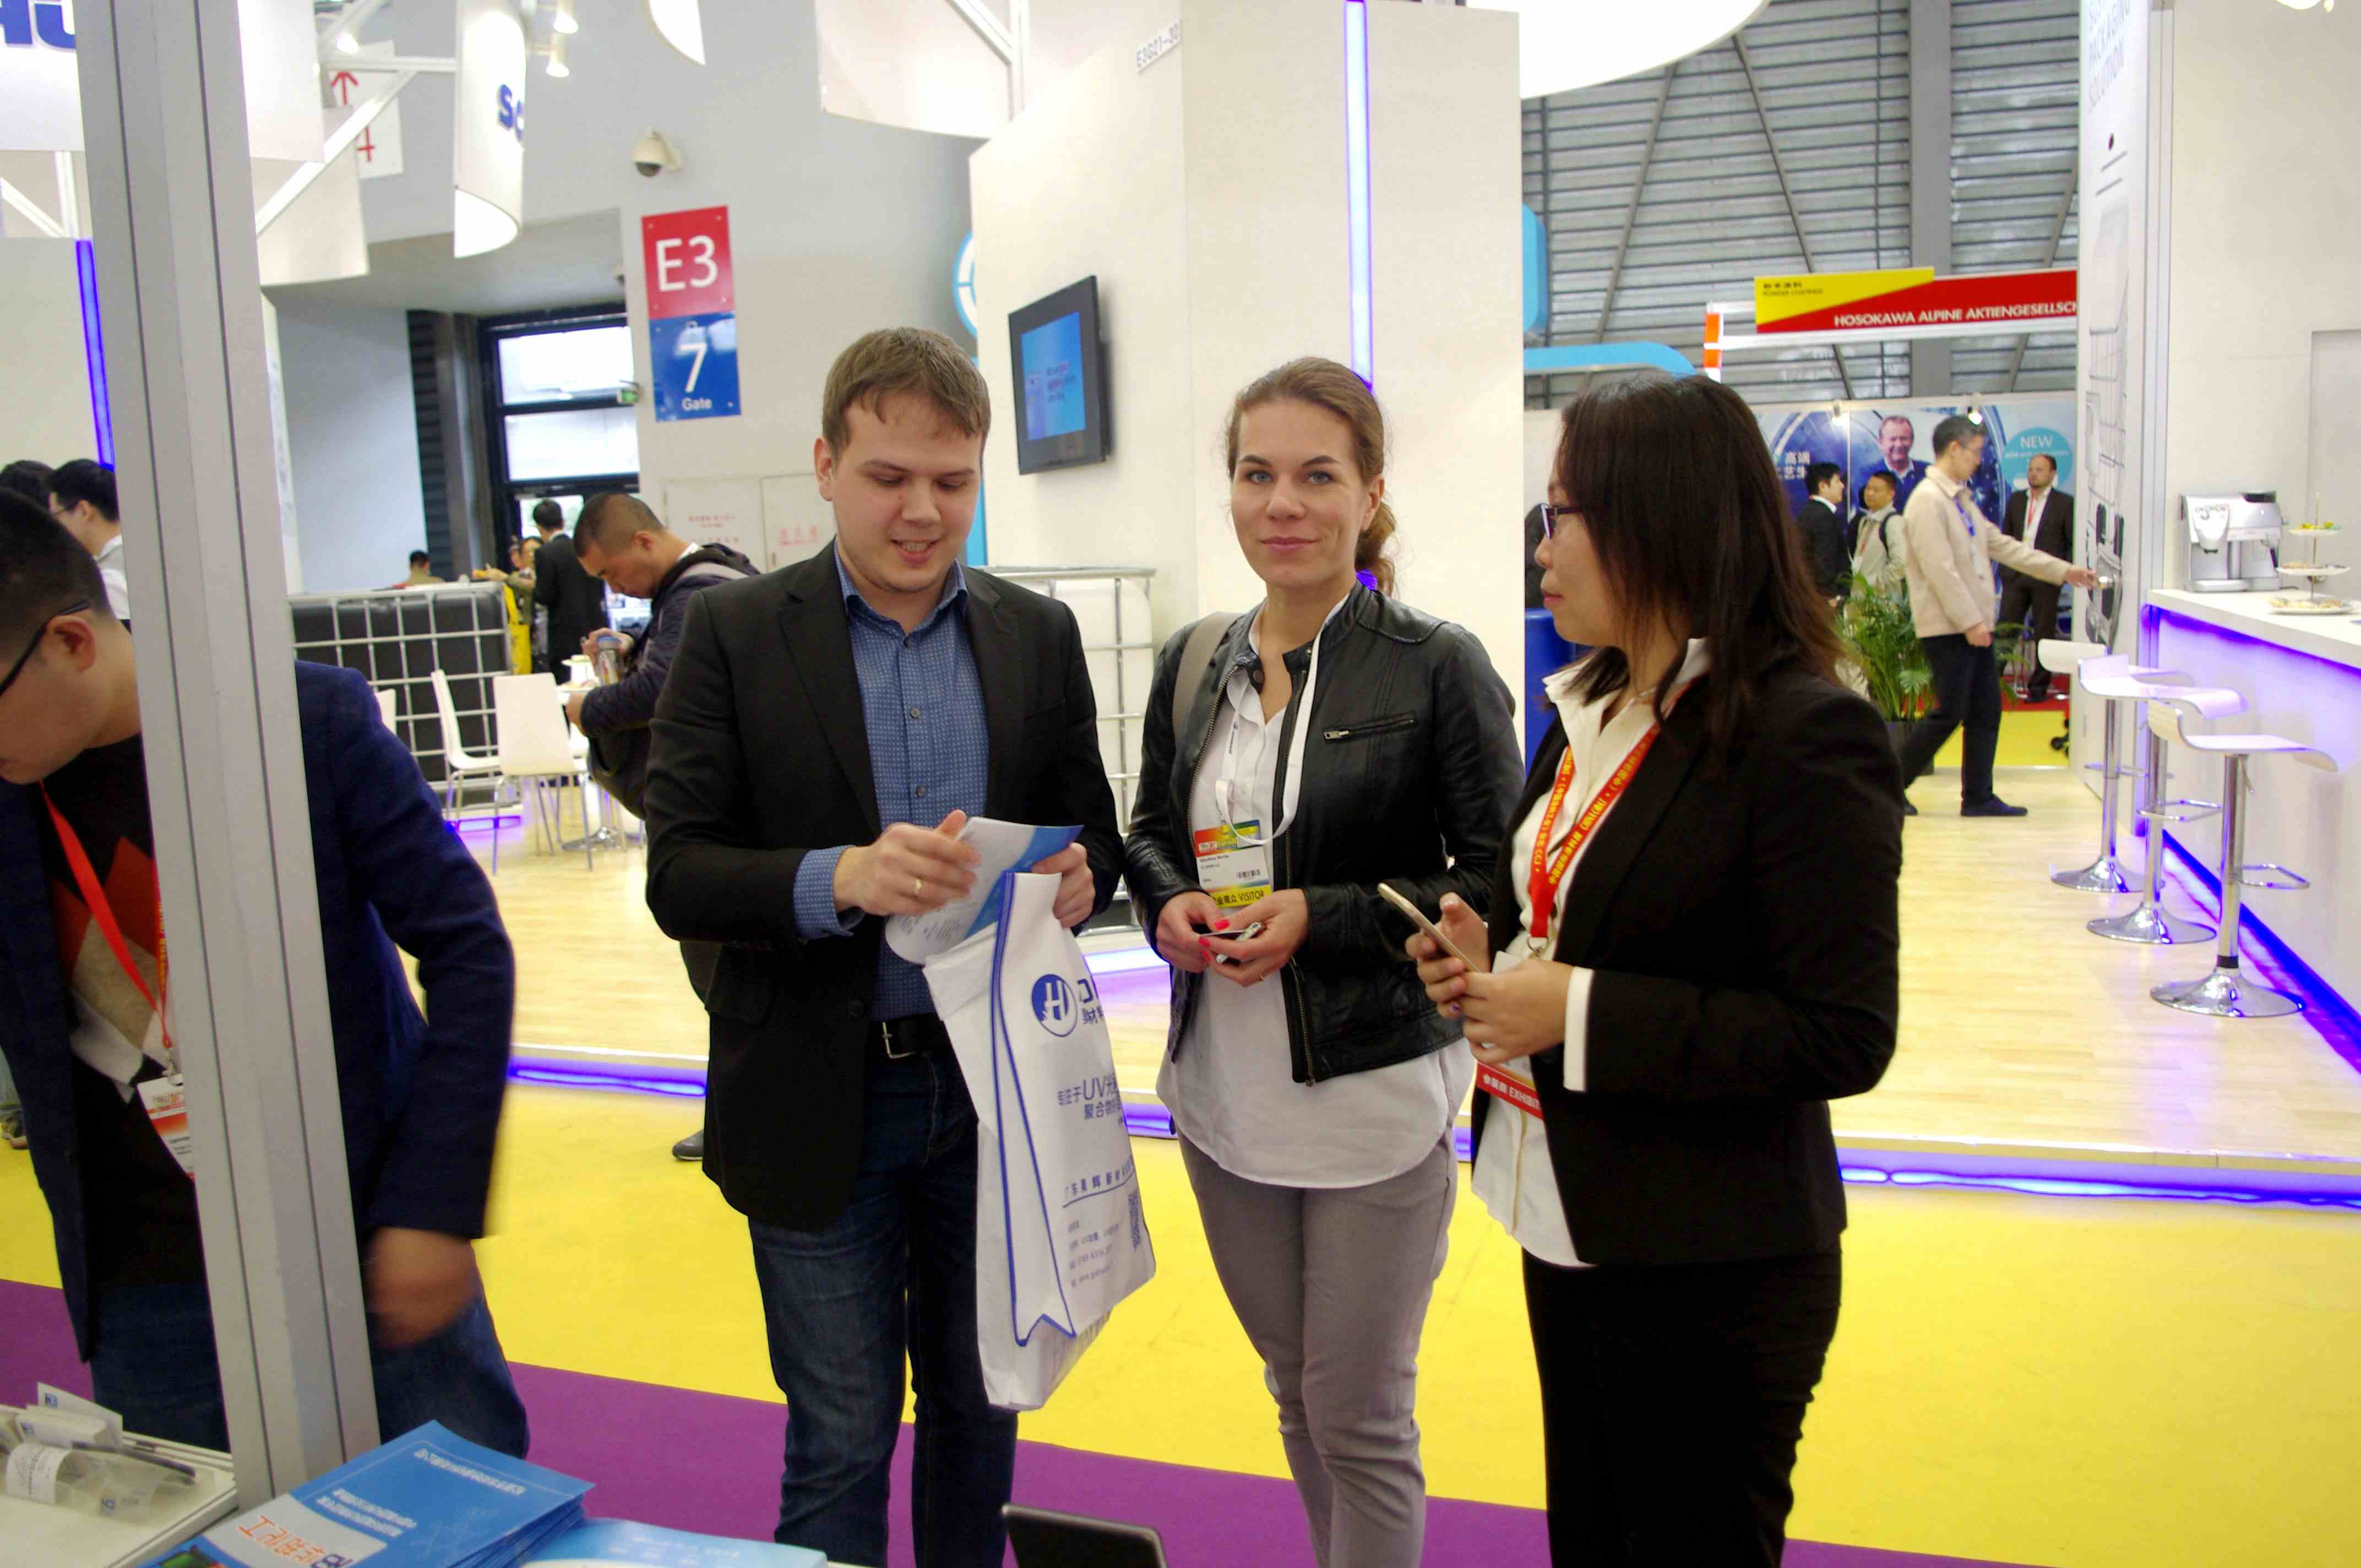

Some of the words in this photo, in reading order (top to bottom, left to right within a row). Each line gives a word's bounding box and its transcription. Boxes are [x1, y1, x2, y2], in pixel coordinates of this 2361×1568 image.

[656, 235, 718, 292] E3
[1834, 311, 1916, 327] HOSOKAWA
[1918, 308, 1963, 322] ALPINE
[678, 342, 708, 393] 7
[682, 396, 712, 411] Gate
[2020, 435, 2053, 448] NEW
[1238, 890, 1264, 901] VISITOR
